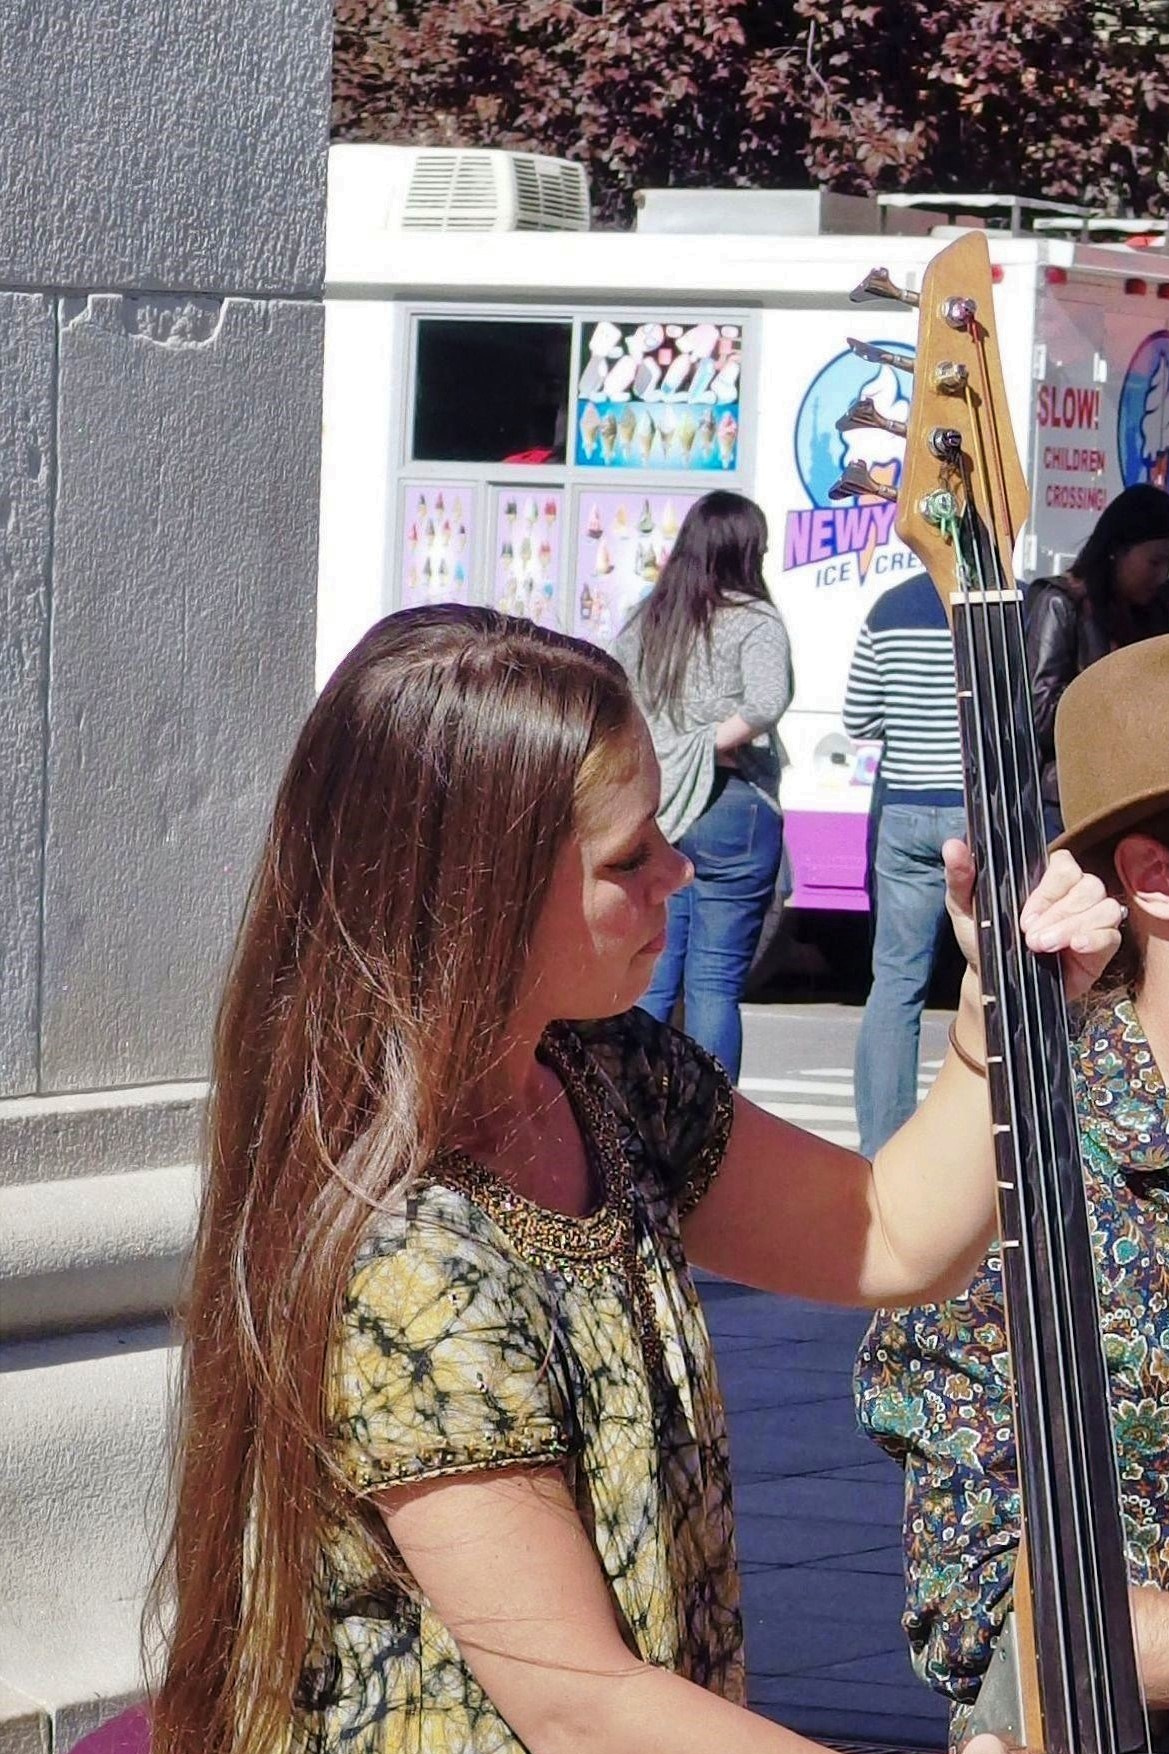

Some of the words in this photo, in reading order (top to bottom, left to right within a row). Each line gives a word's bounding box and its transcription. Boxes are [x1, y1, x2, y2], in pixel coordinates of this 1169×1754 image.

[1038, 385, 1100, 430] SLOW!
[1043, 447, 1107, 472] CHILDREN
[816, 562, 851, 588] ICE
[875, 551, 919, 574] CRE
